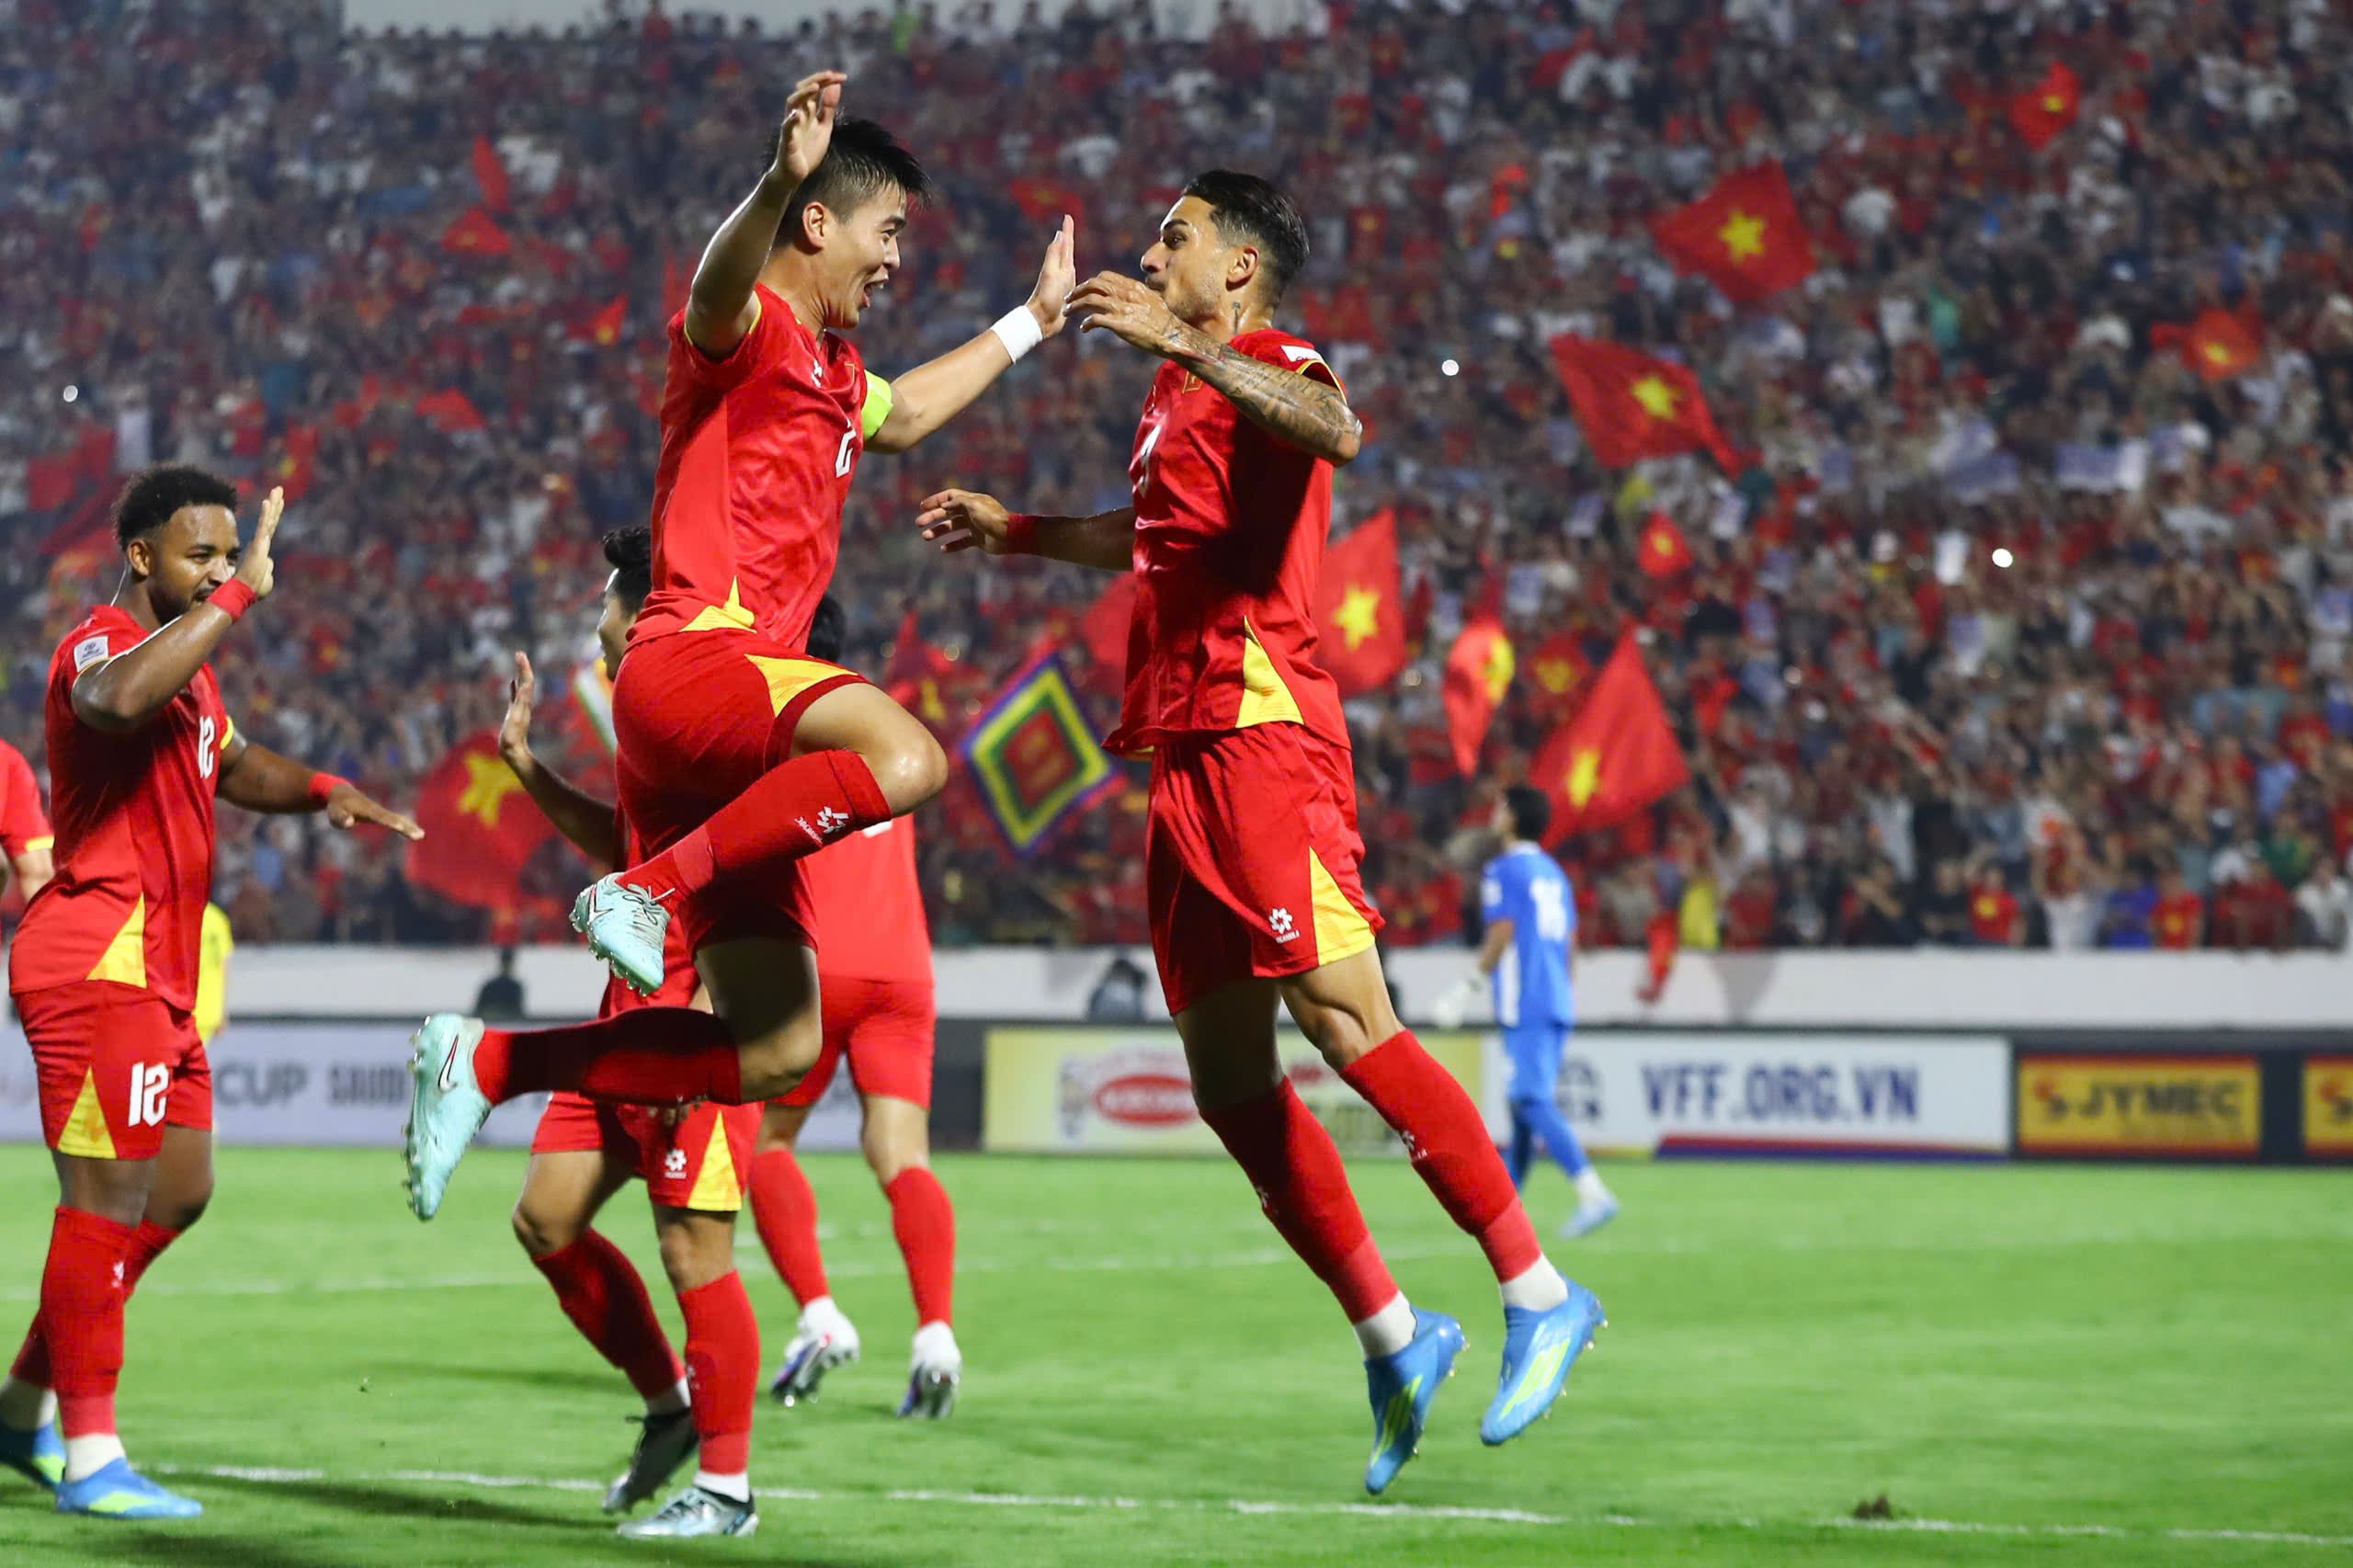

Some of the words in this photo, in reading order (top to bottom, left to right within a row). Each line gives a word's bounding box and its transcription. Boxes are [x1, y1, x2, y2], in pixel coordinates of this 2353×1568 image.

[198, 715, 215, 779] 12
[128, 1060, 170, 1128] 12
[213, 1062, 309, 1107] CUP
[1641, 1062, 1920, 1122] VFF.ORG.VN
